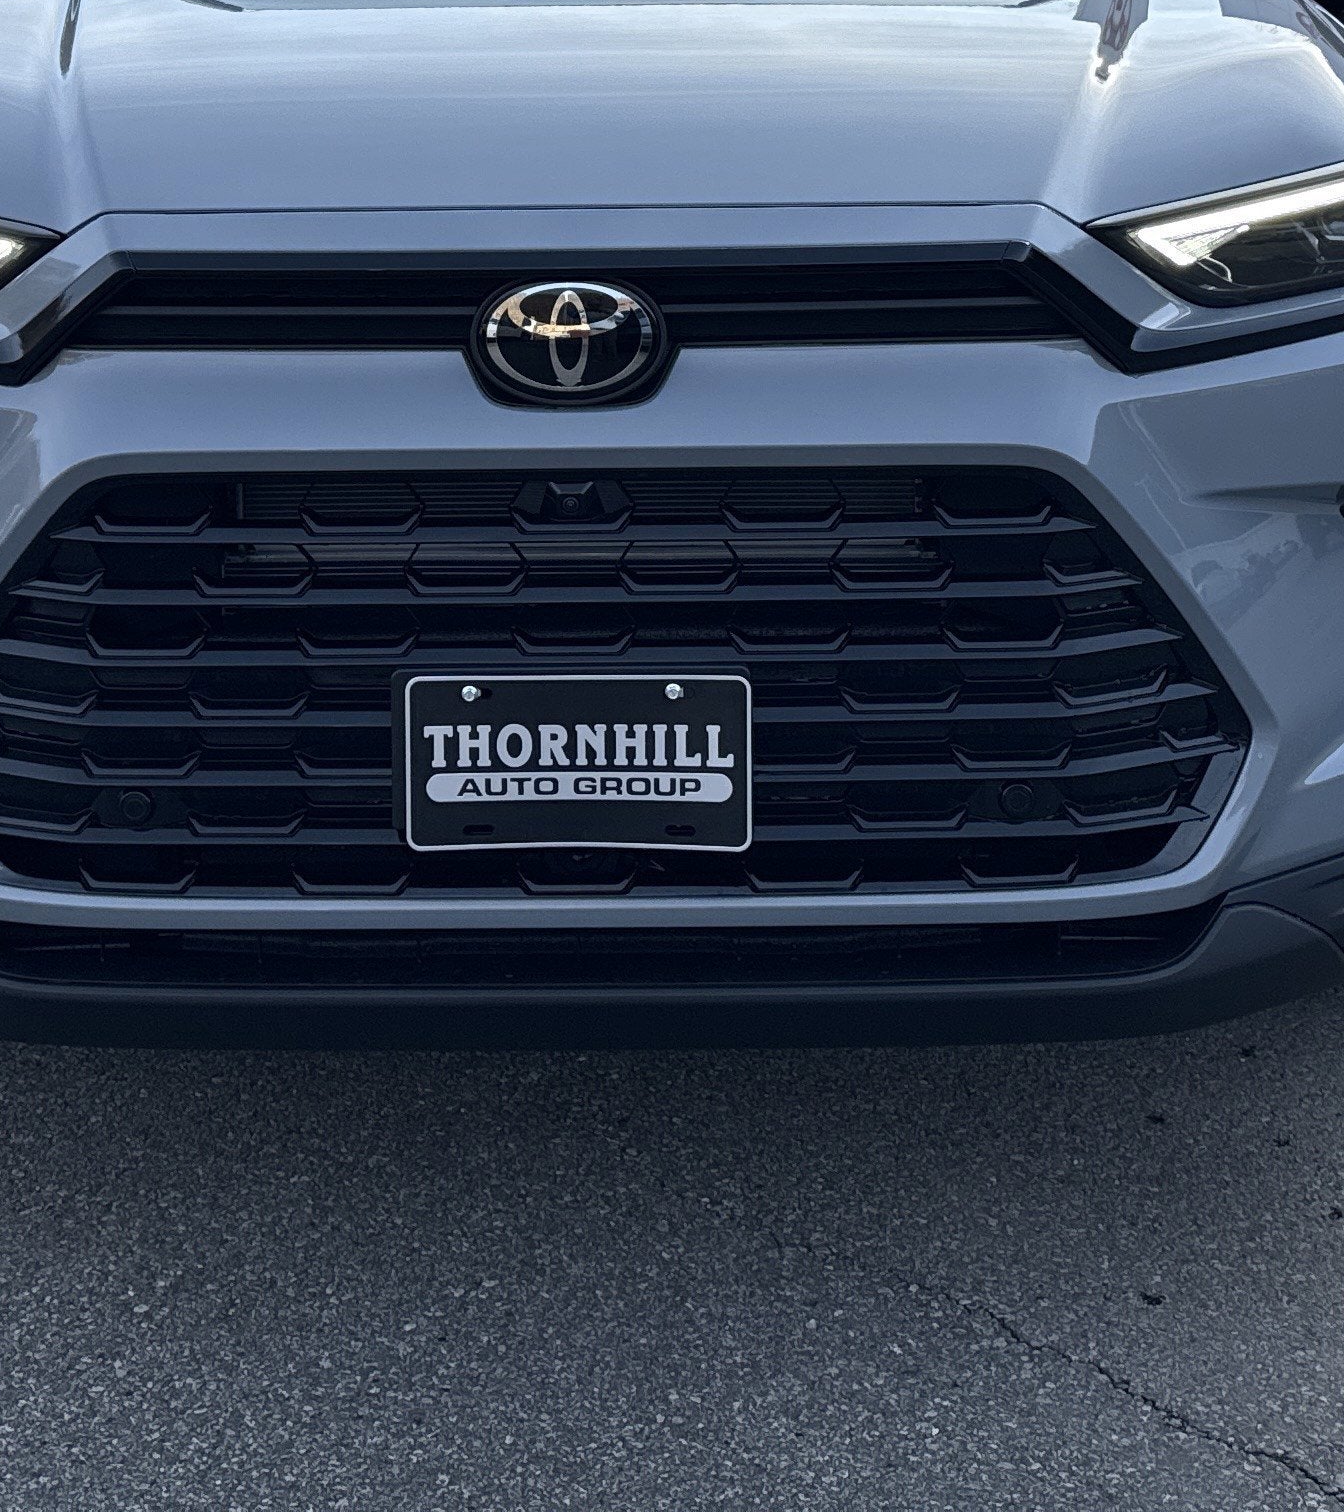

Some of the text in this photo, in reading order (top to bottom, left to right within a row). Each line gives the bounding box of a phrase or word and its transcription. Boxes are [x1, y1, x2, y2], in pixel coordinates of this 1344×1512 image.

[423, 723, 735, 768] THORNHILL
[457, 776, 702, 797] AUTO GROUP
